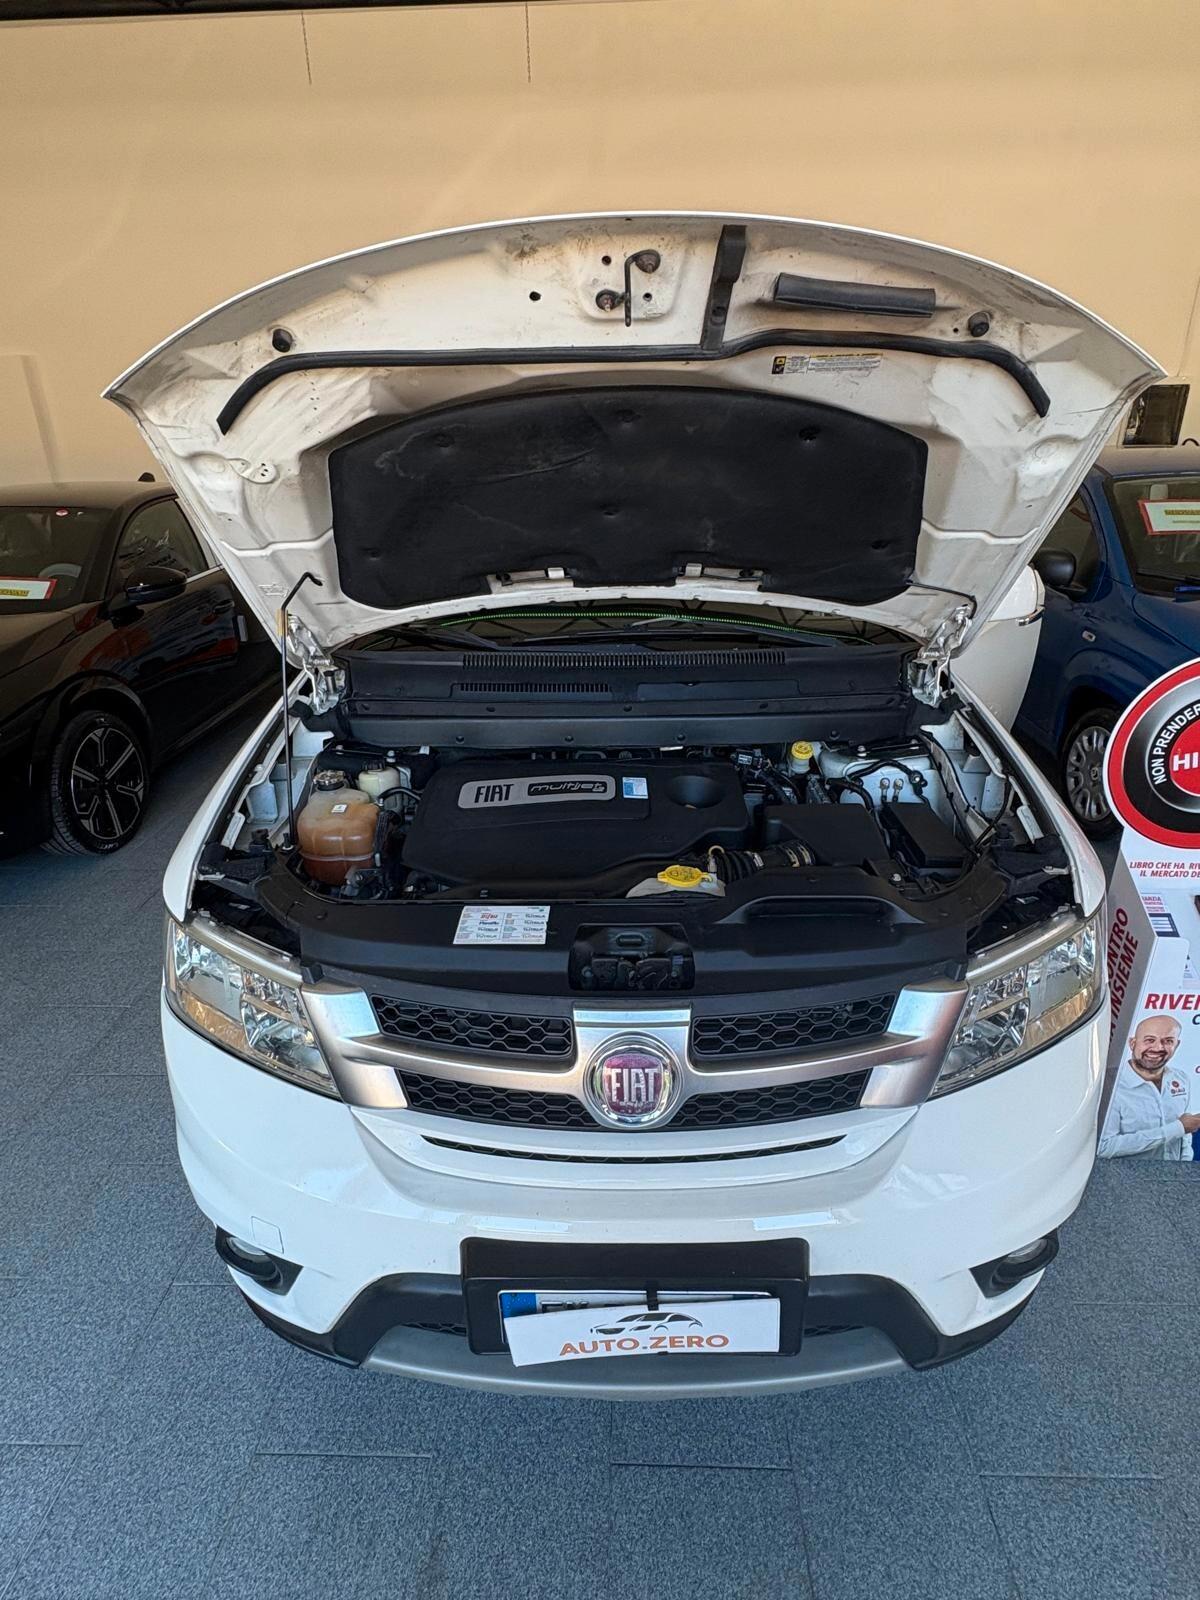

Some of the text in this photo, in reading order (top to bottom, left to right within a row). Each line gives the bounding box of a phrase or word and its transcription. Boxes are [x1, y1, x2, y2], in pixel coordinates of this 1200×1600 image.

[1151, 759, 1167, 785] NON
[474, 784, 514, 803] FIAT
[1150, 870, 1189, 878] MERCATO
[611, 1068, 658, 1102] FIAT
